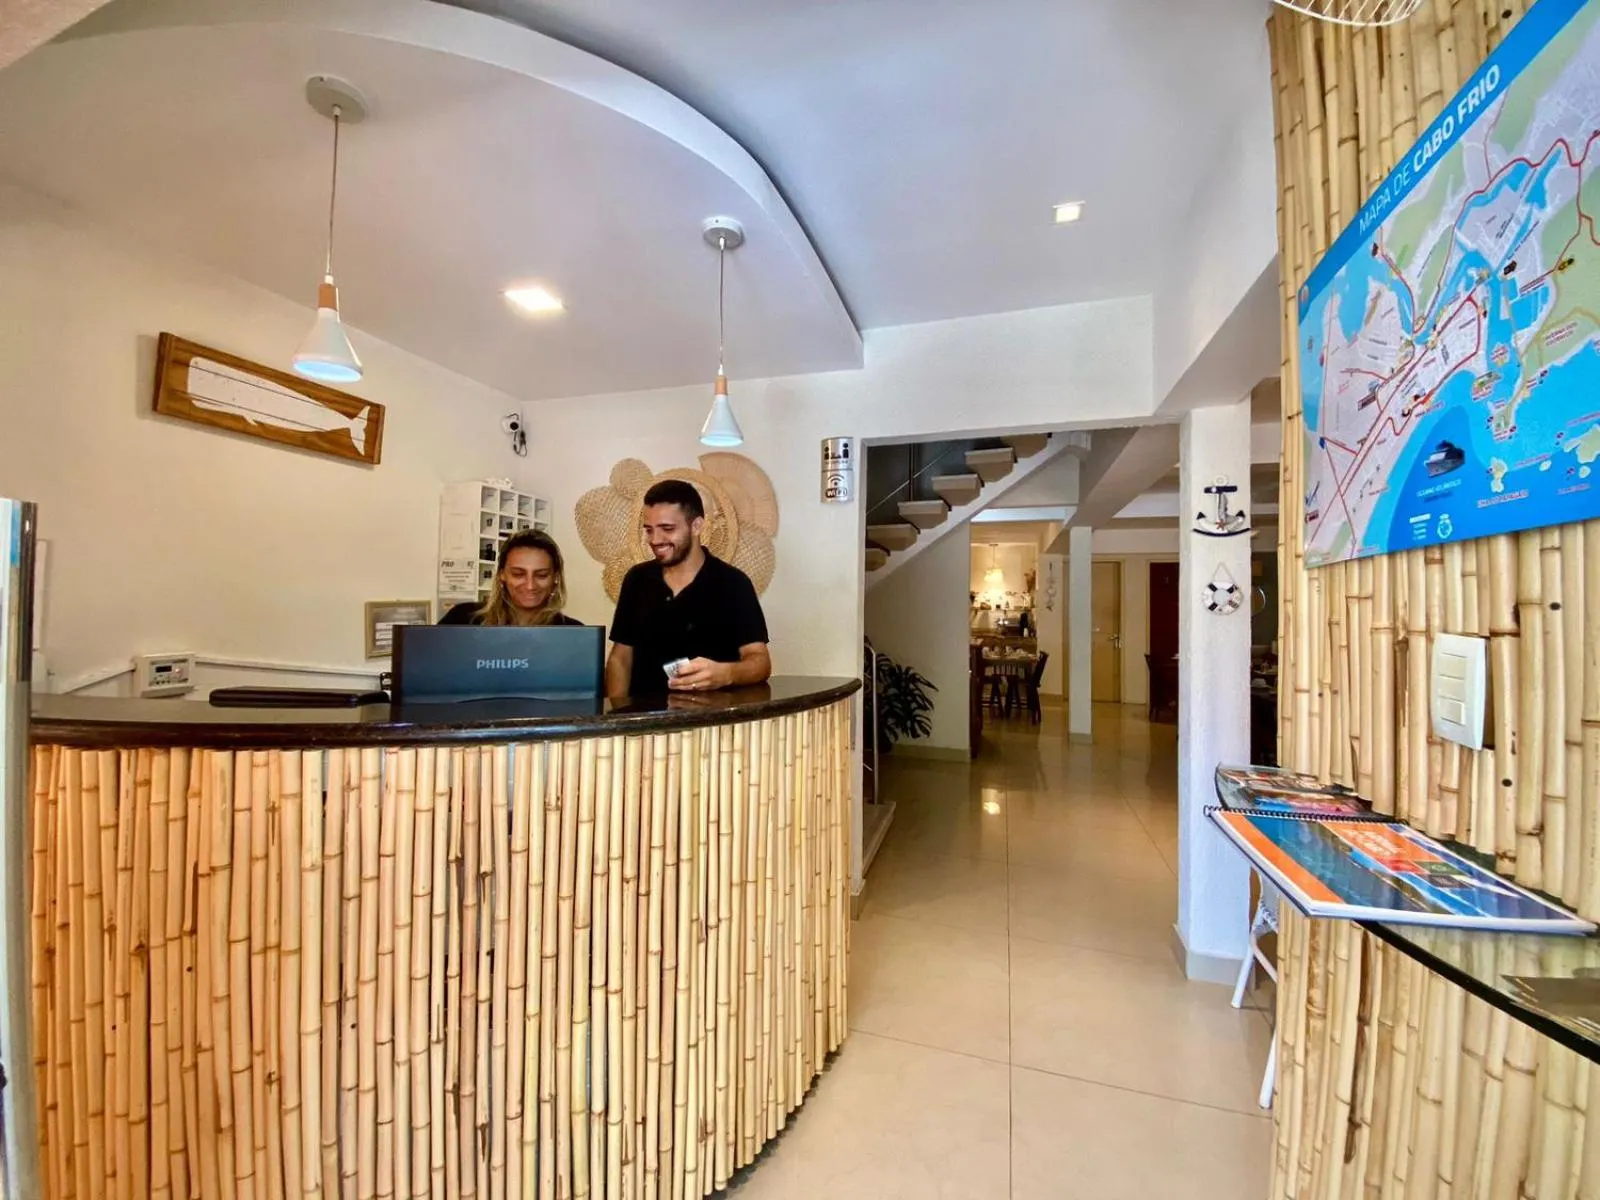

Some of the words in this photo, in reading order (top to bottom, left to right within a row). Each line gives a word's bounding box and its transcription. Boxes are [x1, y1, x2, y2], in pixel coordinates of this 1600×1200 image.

[1359, 187, 1391, 236] MAPA
[1393, 162, 1411, 196] DE
[1413, 115, 1455, 172] CABO
[1457, 64, 1500, 124] FRIO
[476, 658, 529, 670] PHILIPS
